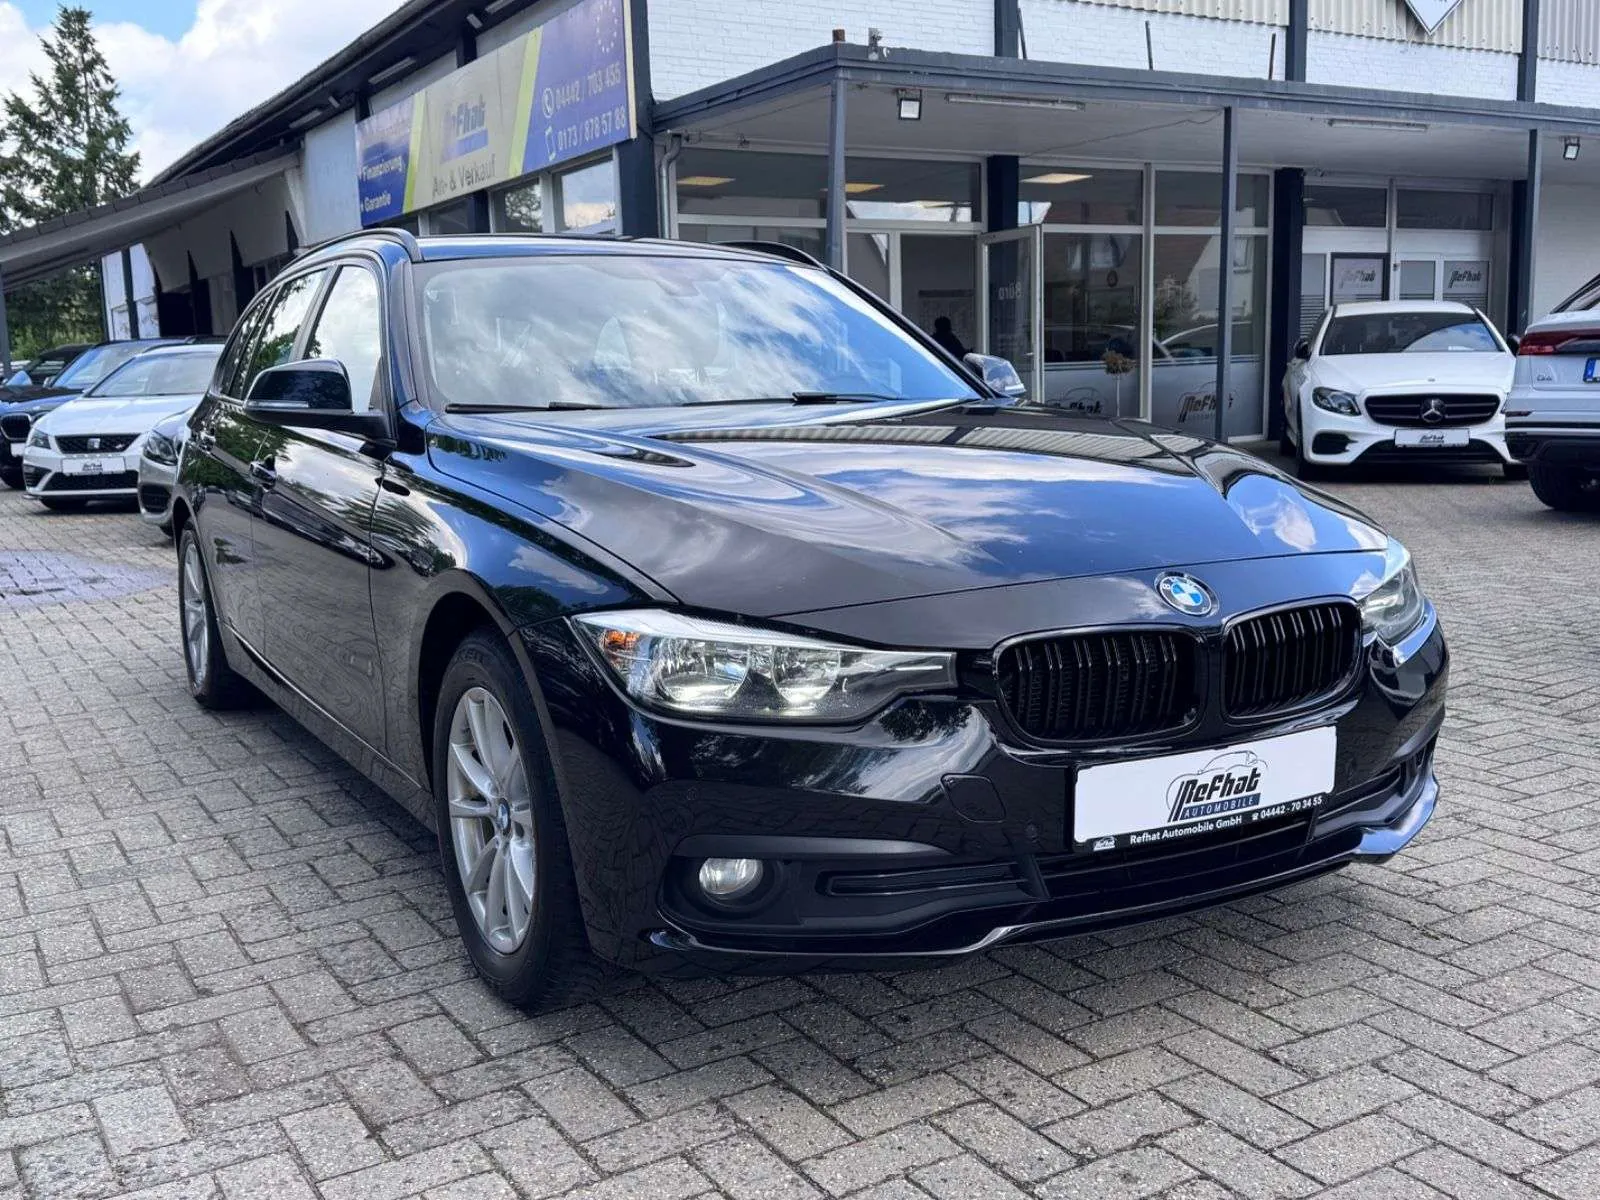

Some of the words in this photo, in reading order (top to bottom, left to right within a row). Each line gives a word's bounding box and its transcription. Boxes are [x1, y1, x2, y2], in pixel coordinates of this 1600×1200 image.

[558, 125, 578, 151] 0173
[585, 116, 601, 142] 878
[601, 110, 613, 136] 57
[1178, 393, 1234, 423] Refht
[1184, 796, 1254, 818] AUTOMOBILE
[1260, 805, 1286, 819] 04442
[1291, 801, 1301, 812] 70
[1130, 831, 1160, 845] Refhat
[1162, 821, 1214, 840] Automobile
[1216, 815, 1242, 829] GmbH
